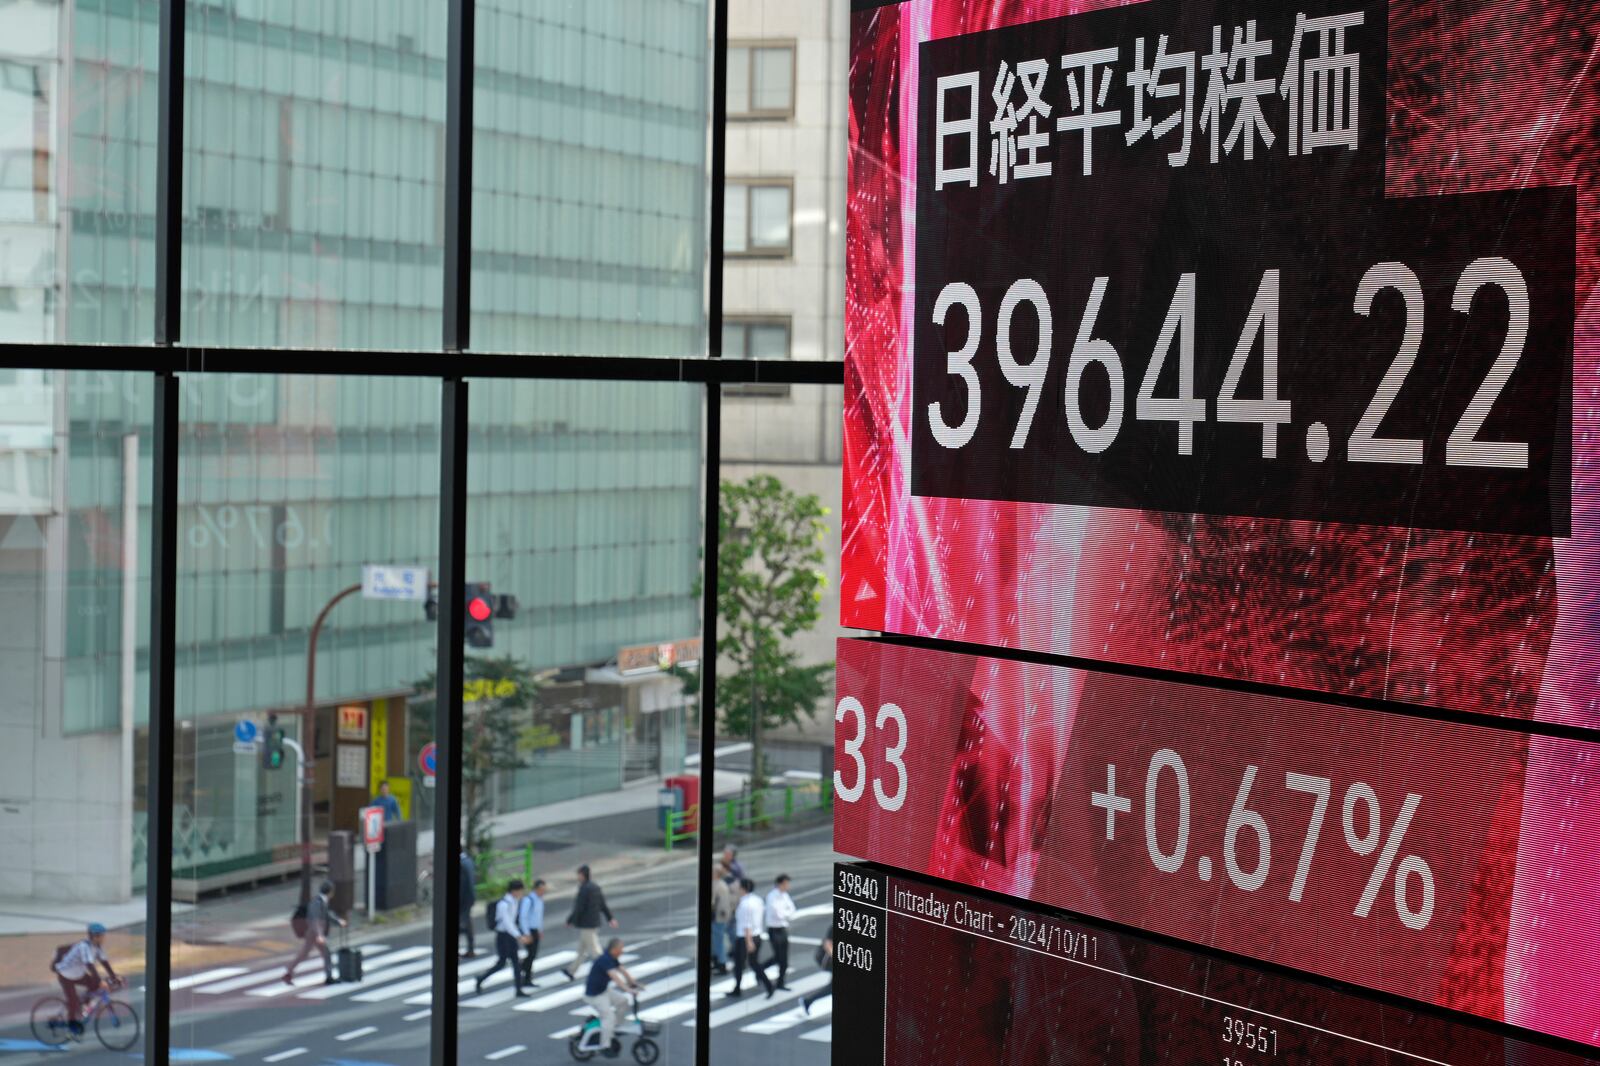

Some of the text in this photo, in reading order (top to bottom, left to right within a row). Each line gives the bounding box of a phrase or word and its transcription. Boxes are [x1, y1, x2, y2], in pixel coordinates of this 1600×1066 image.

[934, 11, 1366, 191] 日経平均株価
[928, 257, 1530, 469] 39644.22
[1091, 748, 1436, 931] +0.67%
[838, 870, 878, 902] 39840
[837, 907, 878, 940] 39428
[894, 885, 950, 926] Intraday
[954, 901, 994, 933] Chart
[1009, 915, 1099, 961] 2024/10/11
[837, 940, 873, 972] 09:00
[1222, 1016, 1277, 1056] 39551
